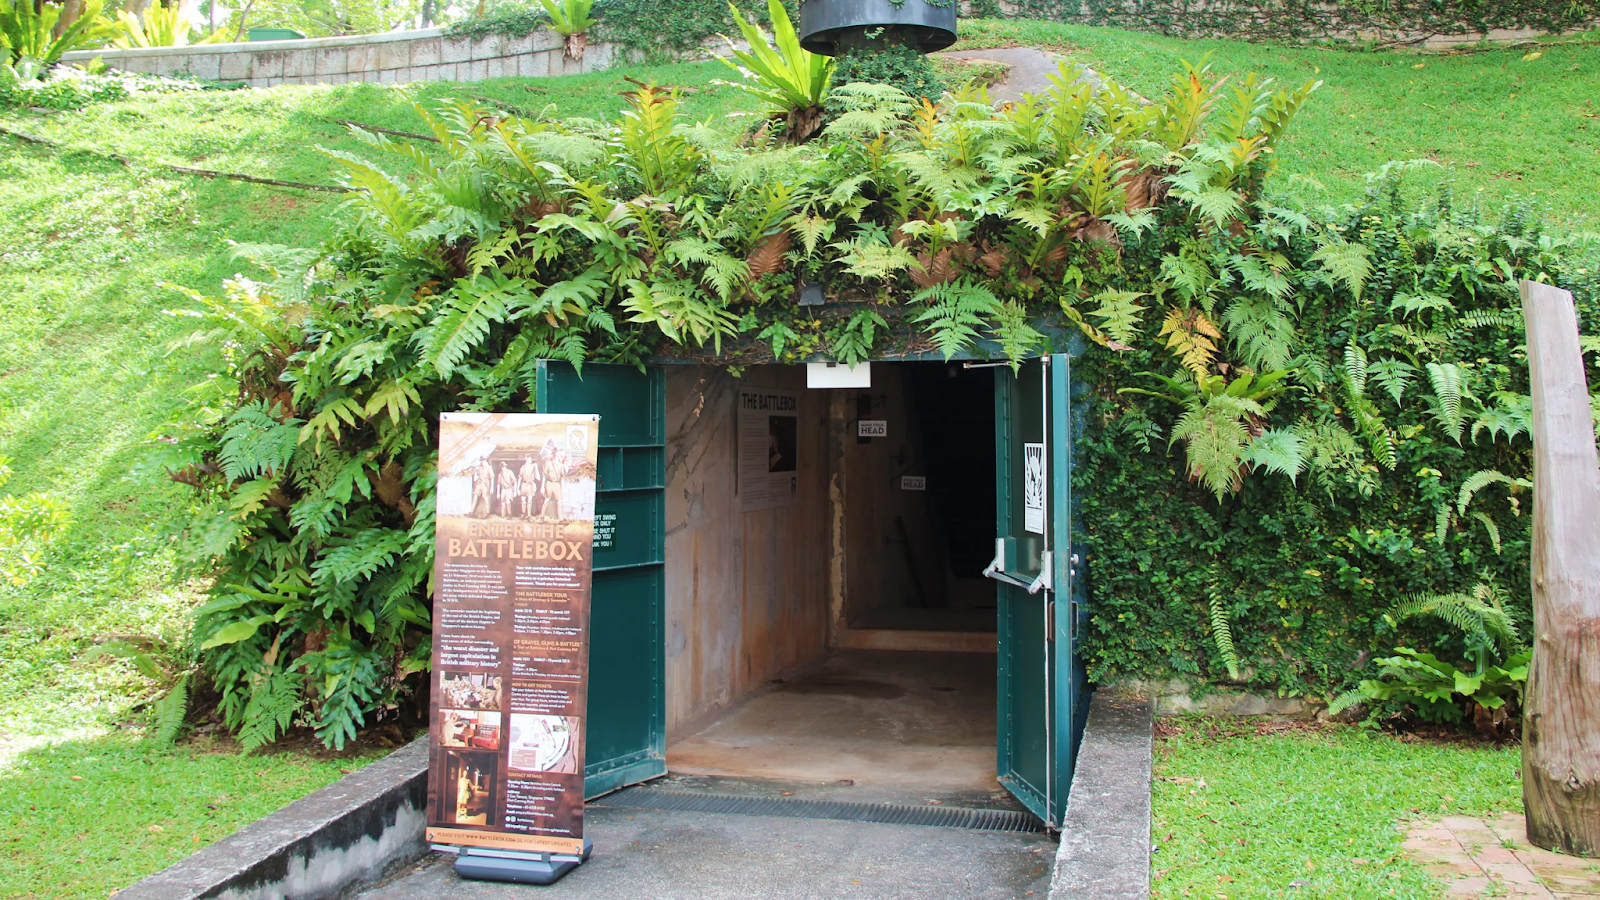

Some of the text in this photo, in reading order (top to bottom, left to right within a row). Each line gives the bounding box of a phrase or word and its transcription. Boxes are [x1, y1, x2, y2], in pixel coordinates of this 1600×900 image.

[742, 393, 797, 411] THE BATTLEBOX
[468, 522, 564, 539] ENTER THE
[448, 538, 584, 561] BATTLEBOX
[459, 653, 490, 661] capitulation
[459, 660, 479, 668] military
